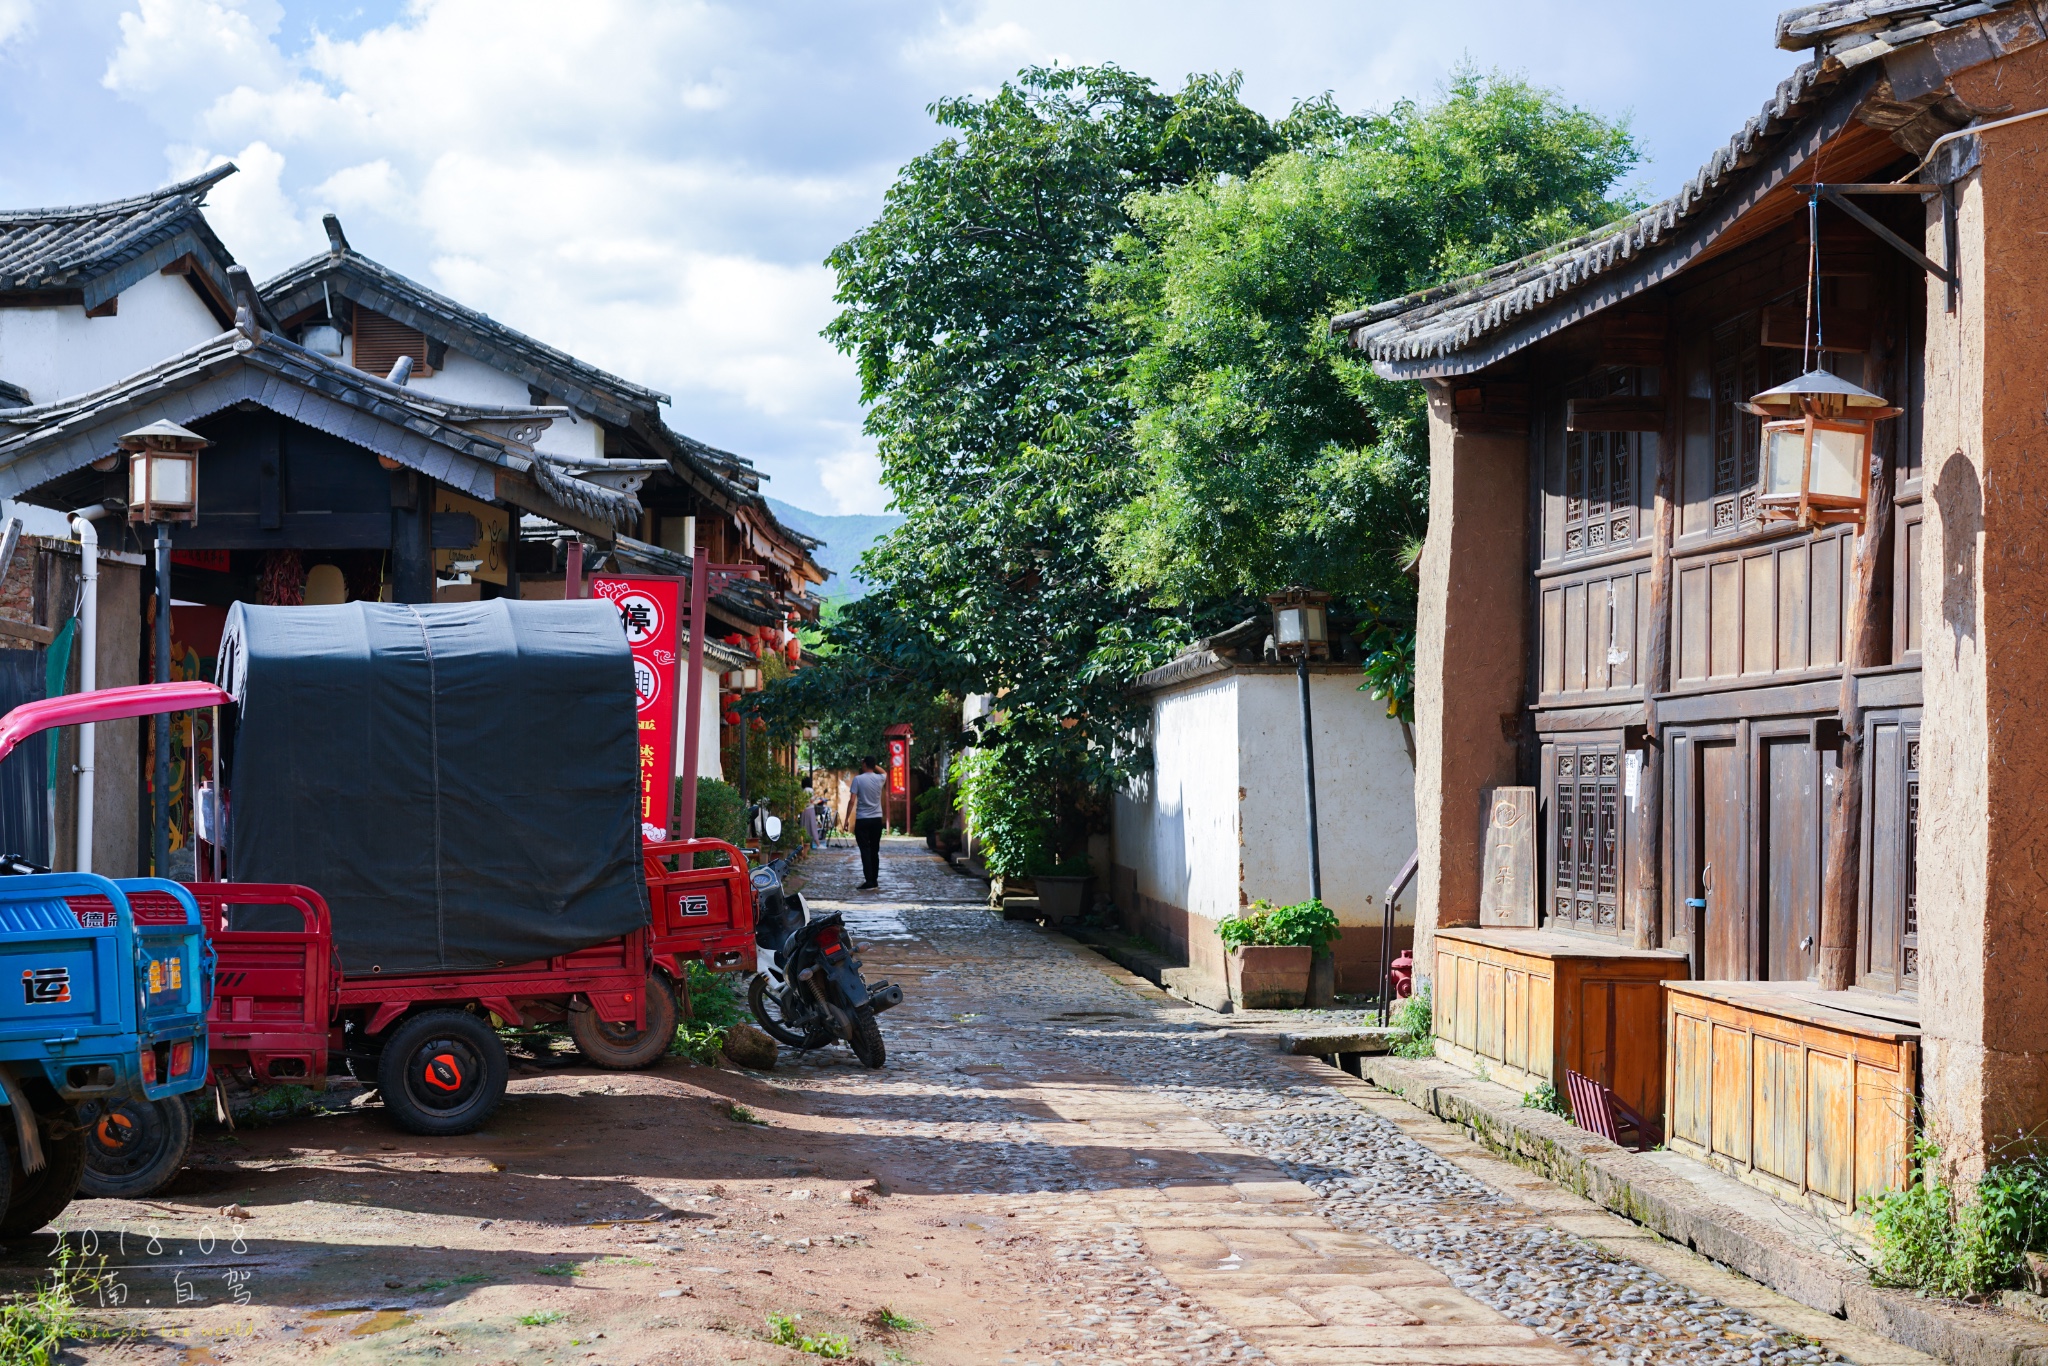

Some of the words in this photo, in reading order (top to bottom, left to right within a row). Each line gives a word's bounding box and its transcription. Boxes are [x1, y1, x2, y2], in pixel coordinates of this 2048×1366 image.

[621, 604, 651, 635] 停
[679, 895, 708, 917] 运
[21, 967, 71, 1005] 运
